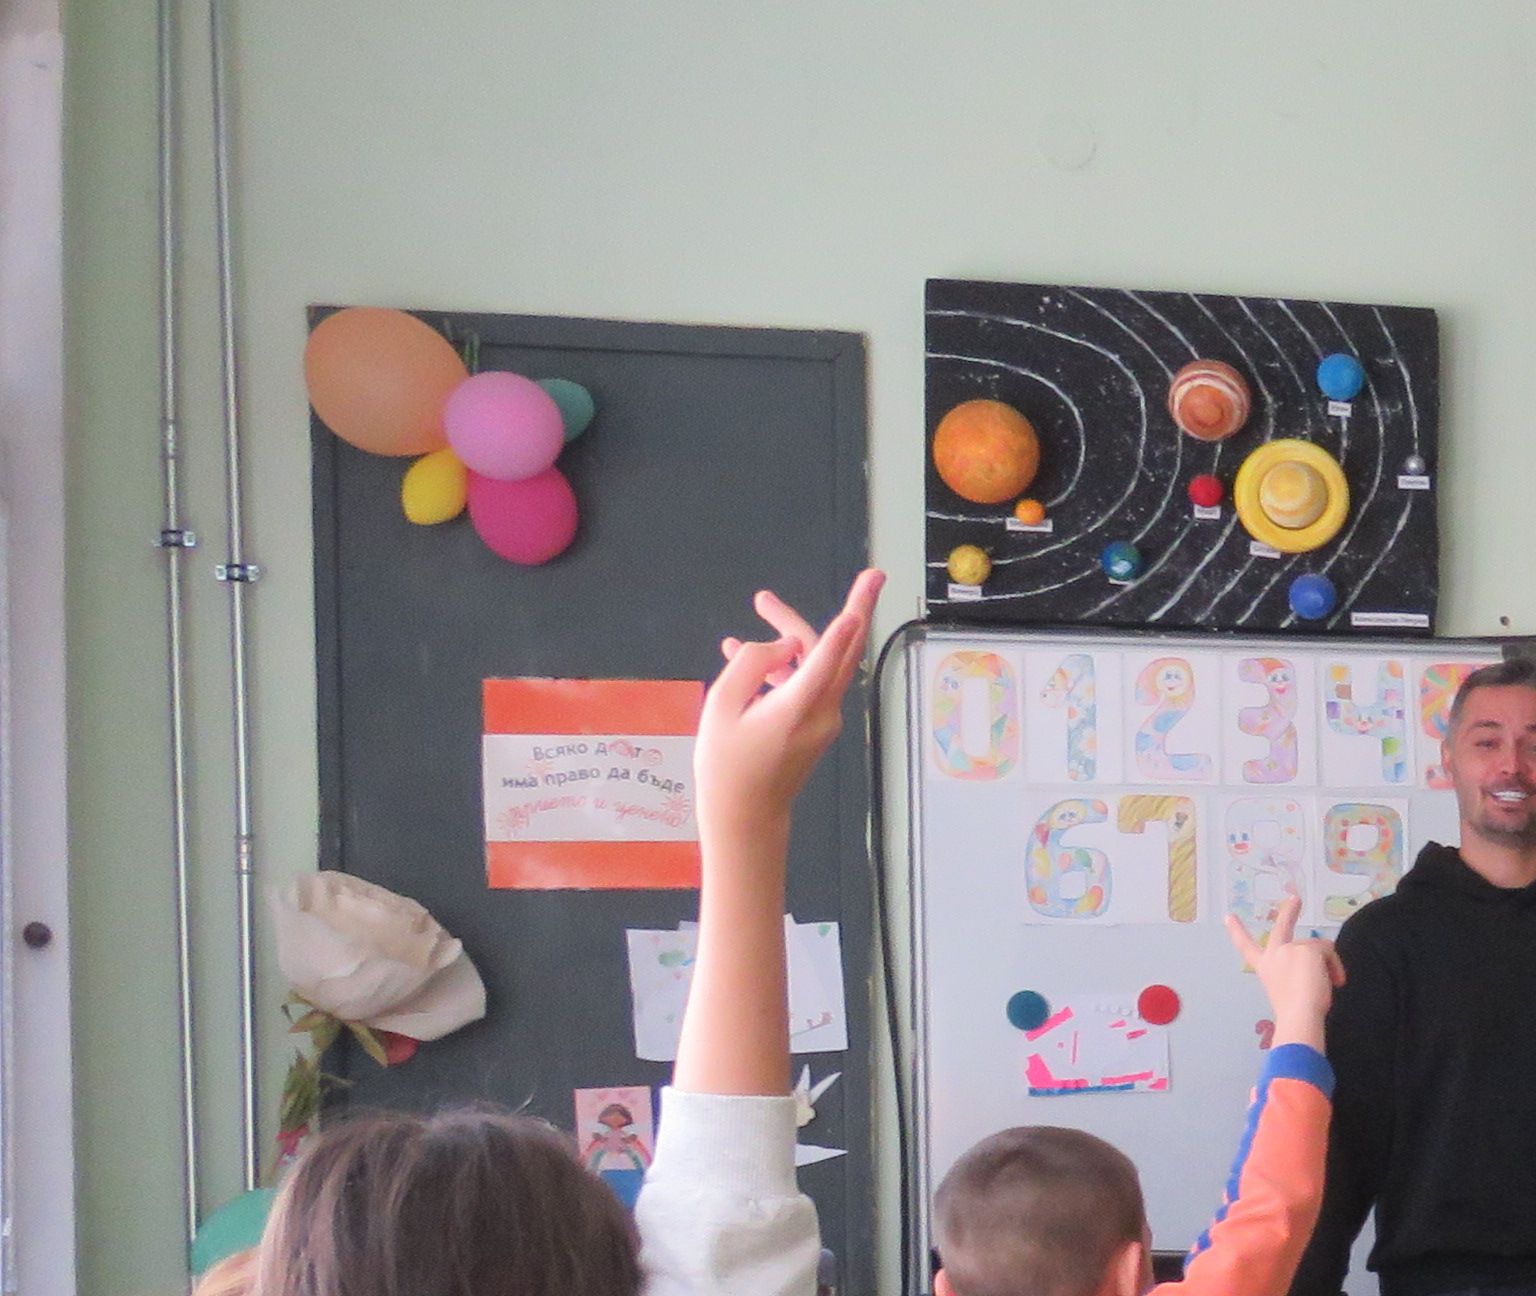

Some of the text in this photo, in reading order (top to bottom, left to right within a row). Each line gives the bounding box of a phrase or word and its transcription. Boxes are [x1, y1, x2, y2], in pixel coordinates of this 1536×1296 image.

[931, 651, 1020, 781] 0
[1041, 654, 1096, 782] 1
[1136, 657, 1212, 781] 2
[1238, 658, 1298, 784] 3
[1326, 660, 1405, 783] 4
[1024, 798, 1112, 919] 6
[1117, 795, 1197, 923] 7
